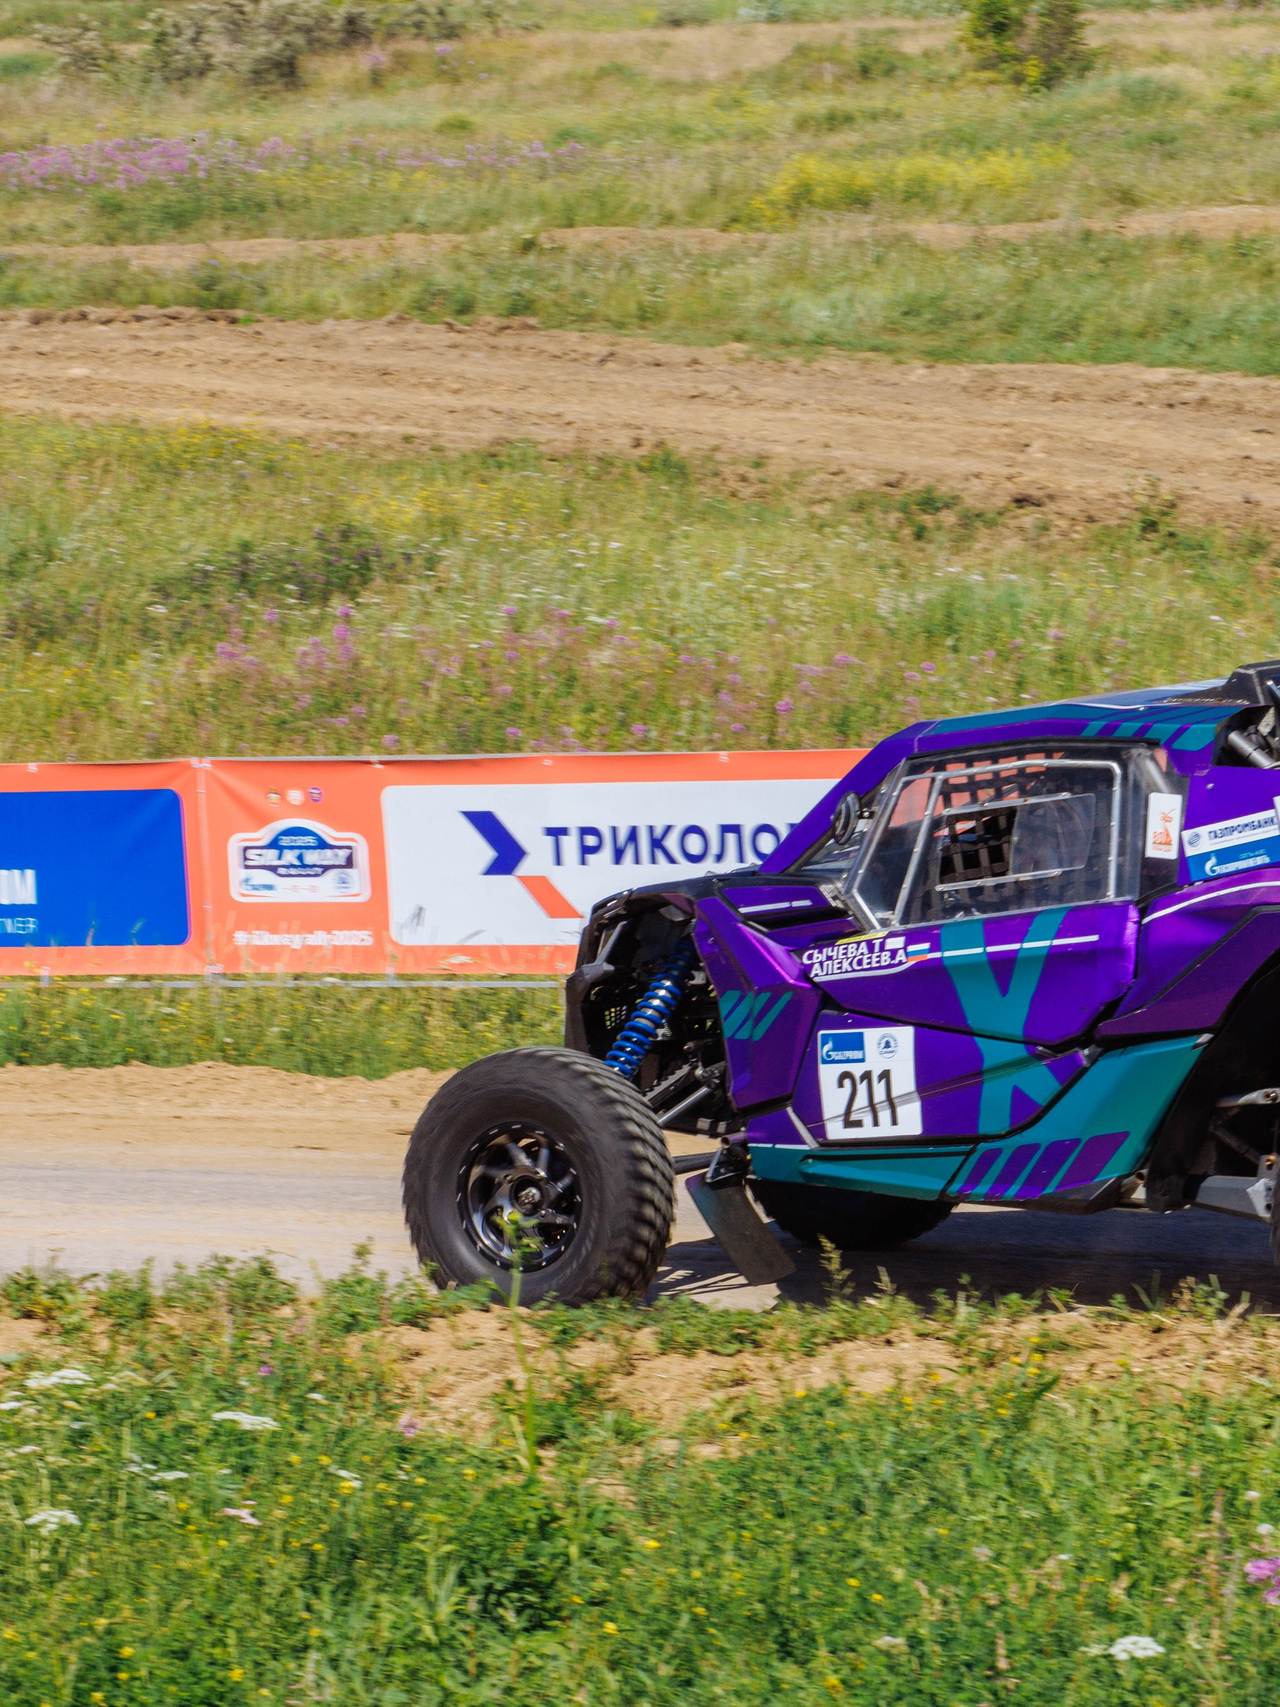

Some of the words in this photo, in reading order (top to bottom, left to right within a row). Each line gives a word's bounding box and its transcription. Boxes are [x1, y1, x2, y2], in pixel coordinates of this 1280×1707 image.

[1208, 816, 1277, 841] ГАЗПРОМБАНК
[541, 822, 799, 866] ТРИКОЛО
[244, 849, 302, 866] SILK
[802, 941, 869, 964] СЫЧЕВА
[837, 1068, 899, 1129] 211
